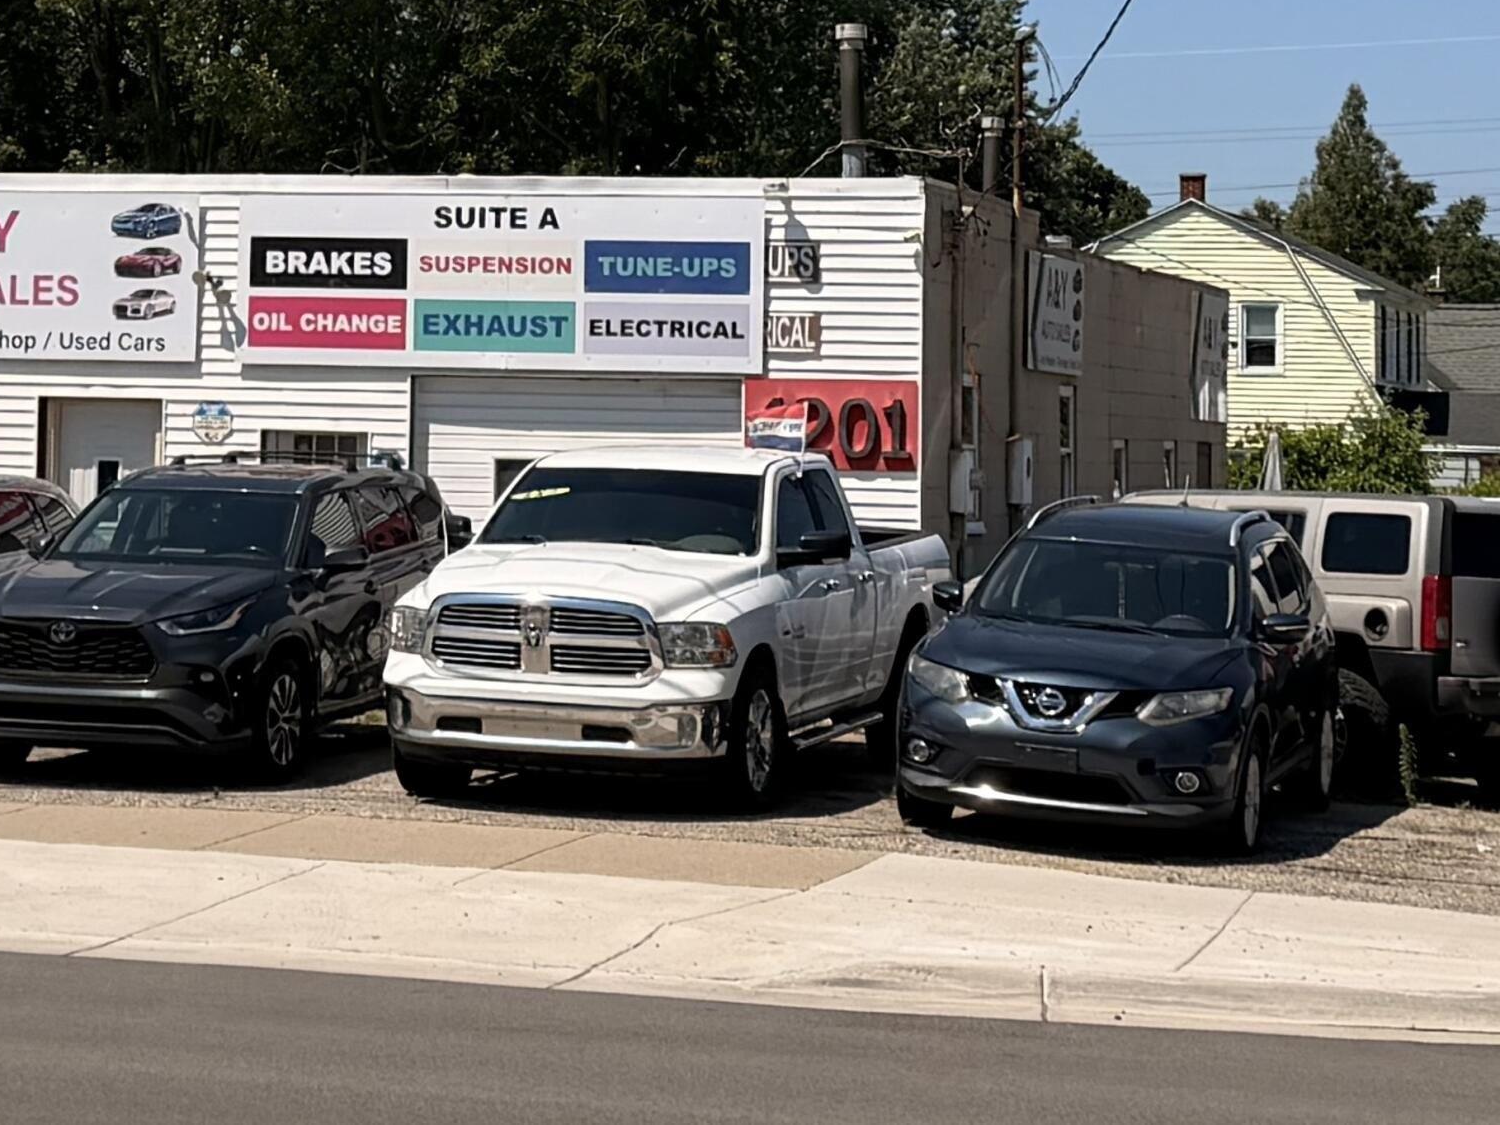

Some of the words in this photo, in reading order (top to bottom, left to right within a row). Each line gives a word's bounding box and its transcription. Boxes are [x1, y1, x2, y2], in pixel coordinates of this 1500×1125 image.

[434, 206, 528, 229] SUITE
[538, 207, 560, 229] A
[265, 251, 393, 276] BRAKES
[419, 255, 572, 274] SUSPENSION
[598, 256, 736, 278] TUNE-UPS
[252, 312, 293, 332] OIL
[299, 313, 402, 334] CHANGE
[422, 314, 569, 338] EXHAUST
[588, 318, 745, 339] ELECTRICAL
[43, 331, 52, 351] /
[59, 331, 111, 351] Used
[118, 332, 166, 352] Cars
